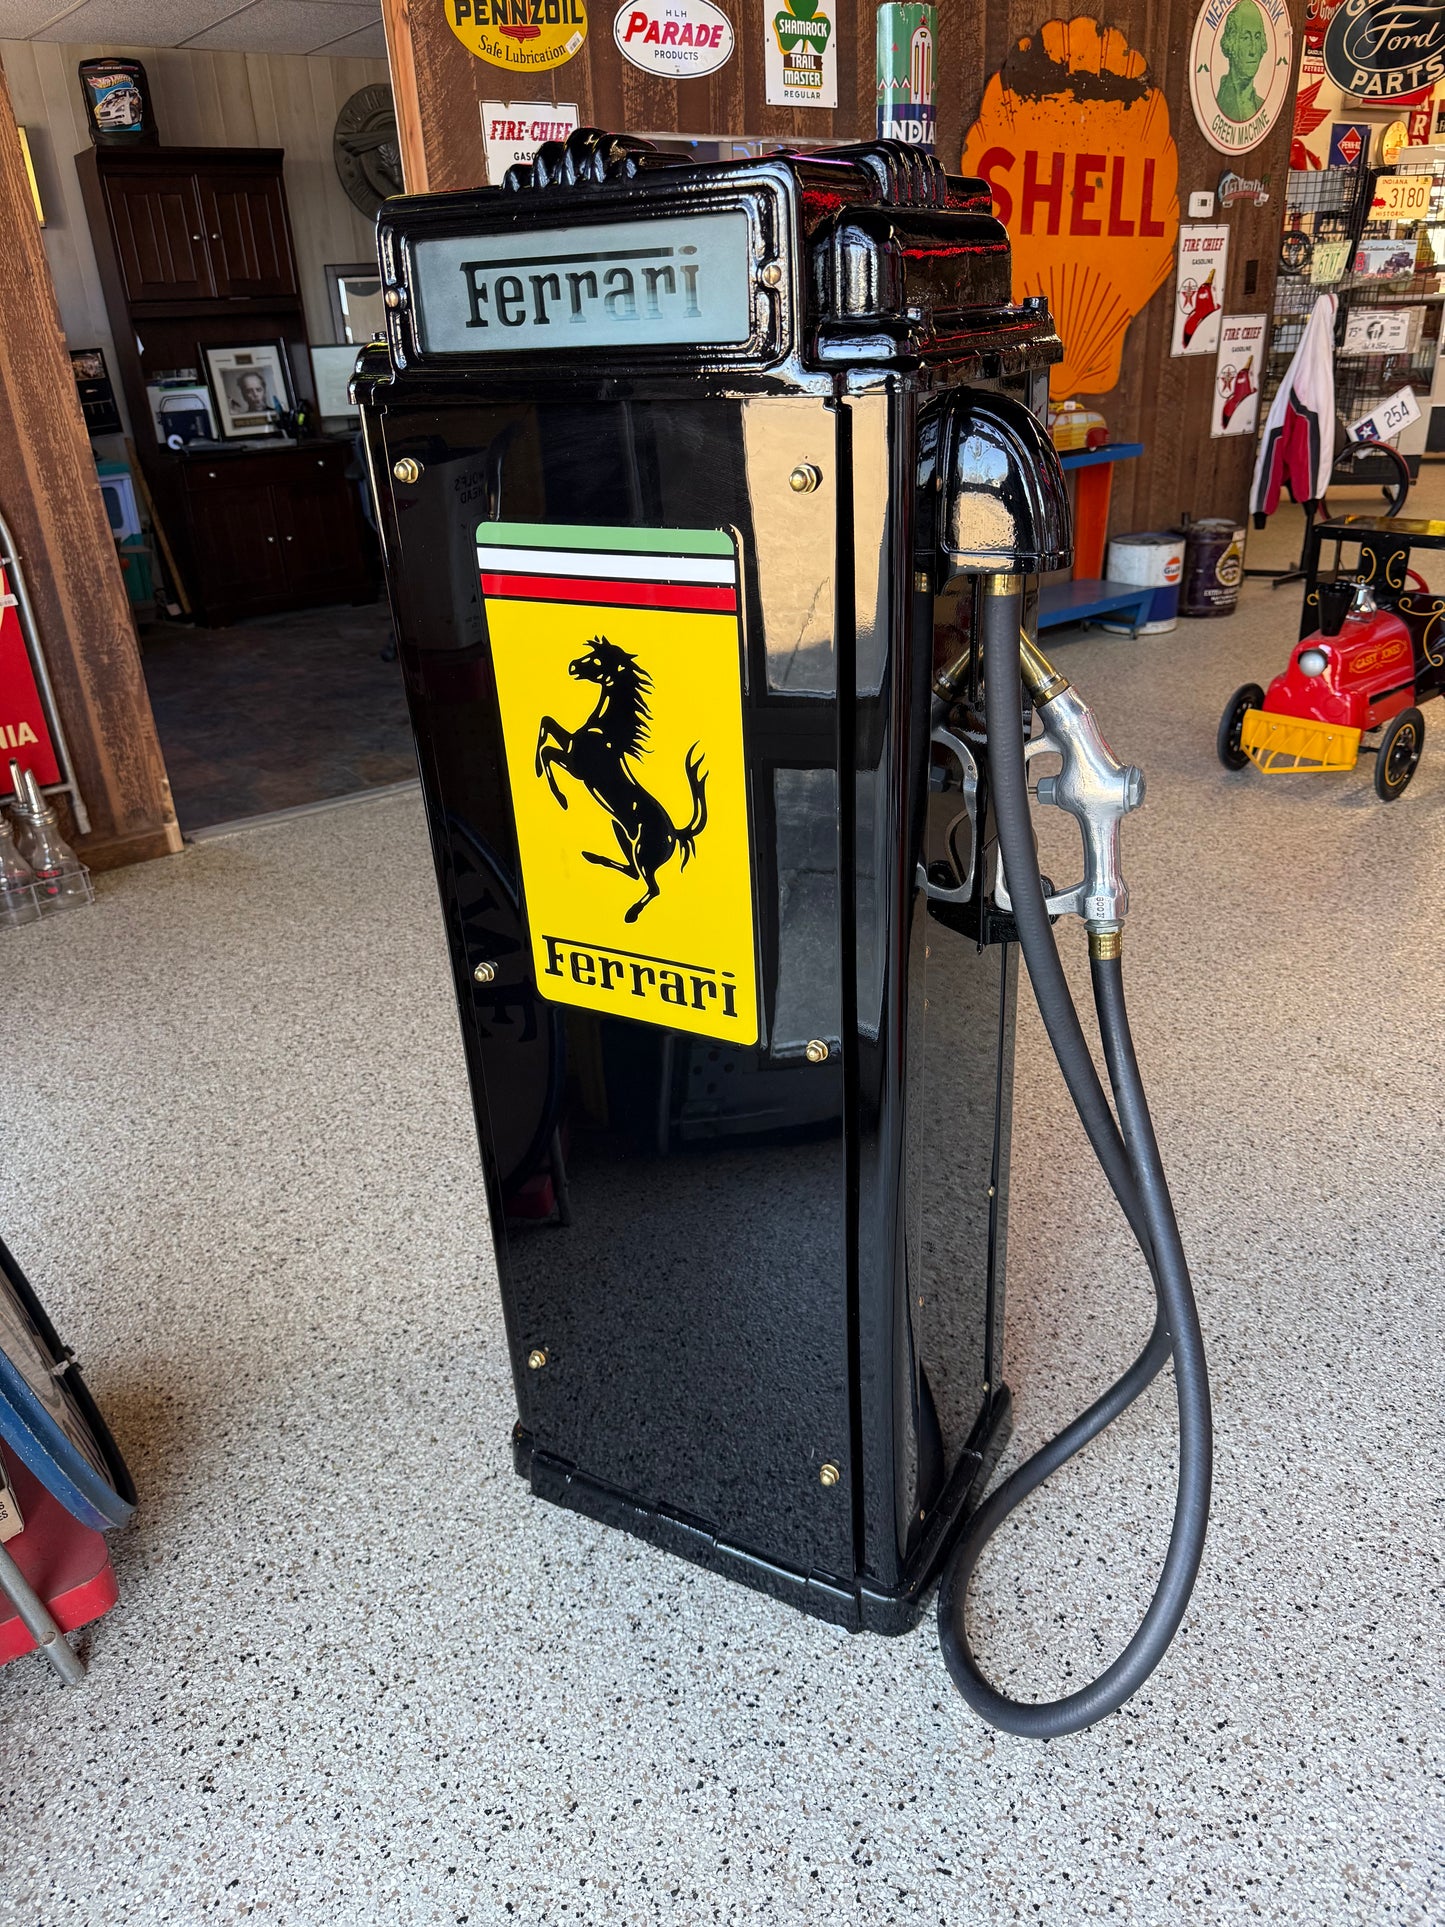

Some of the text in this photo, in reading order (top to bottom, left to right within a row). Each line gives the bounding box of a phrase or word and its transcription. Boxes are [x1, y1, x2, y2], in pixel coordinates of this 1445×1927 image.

[455, 0, 583, 26] PENNZOIL
[1262, 0, 1285, 27] ANK
[622, 11, 724, 48] PARADE
[779, 19, 828, 38] SHAMROCK
[1352, 5, 1445, 60] Ford
[478, 35, 566, 64] Safe Lubrication
[654, 50, 699, 61] PRODUCTS
[790, 53, 817, 70] TRAIL
[784, 71, 822, 87] MASTER
[1349, 54, 1445, 95] PARTS
[784, 90, 821, 100] REGULAR
[881, 113, 937, 145] INDIA
[1211, 108, 1270, 146] GREEN MACHINE
[977, 146, 1166, 238] SHELL
[1382, 178, 1408, 186] INDIANA
[1389, 187, 1425, 209] 3180
[1375, 210, 1406, 218] HISTORIC
[1182, 237, 1225, 252] FIRE CHIEF
[1191, 258, 1214, 266] GASOLINE
[459, 245, 702, 328] Ferrari
[1222, 327, 1263, 341] FIRE CHIEF
[1231, 345, 1252, 353] GASOLINE
[1383, 400, 1410, 428] 254
[1164, 564, 1181, 575] Gulf
[541, 934, 738, 1018] Ferrari
